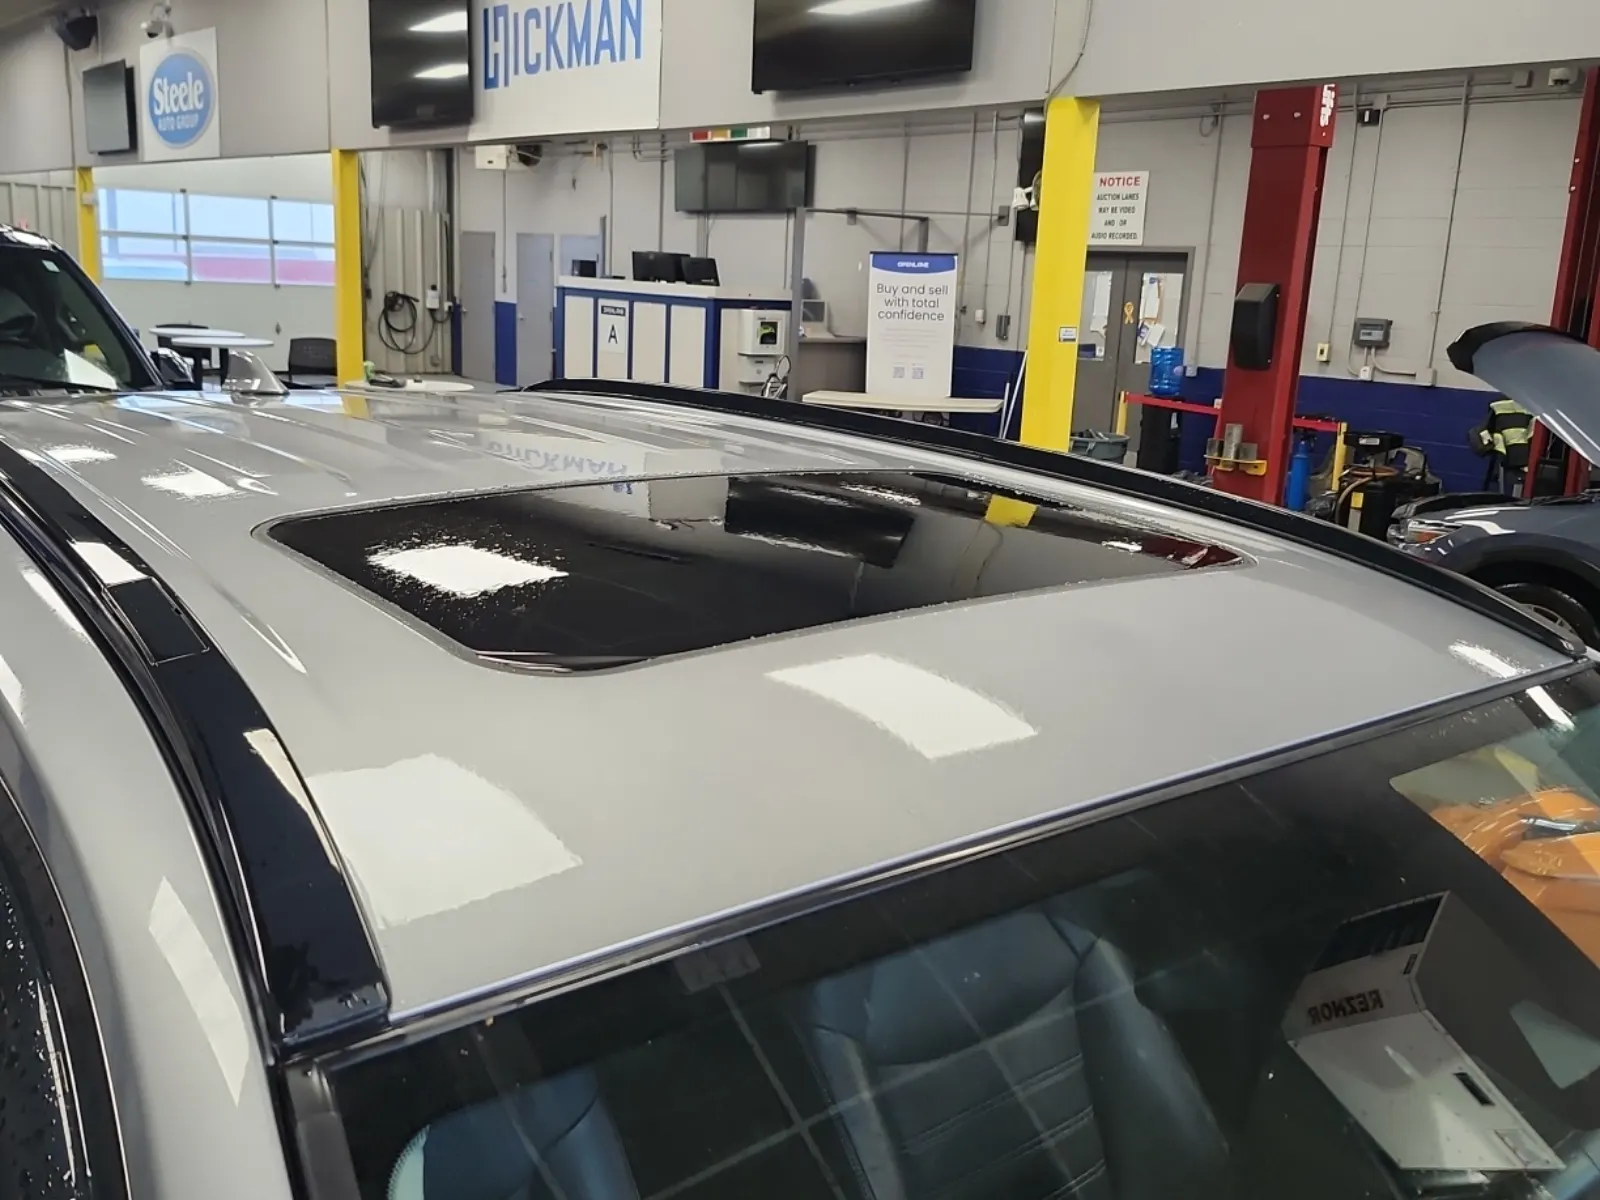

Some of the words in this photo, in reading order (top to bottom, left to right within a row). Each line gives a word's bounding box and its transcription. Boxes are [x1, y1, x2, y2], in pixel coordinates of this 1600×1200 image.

[483, 0, 643, 90] HICKMAN
[153, 71, 204, 116] Steele
[1099, 176, 1141, 187] NOTICE
[1096, 193, 1120, 201] AUCTION
[1121, 193, 1139, 201] LANES
[1098, 206, 1109, 214] MAY
[1111, 206, 1118, 214] BE
[1119, 206, 1136, 214] VIDEO
[1103, 219, 1116, 227] AND
[1118, 219, 1128, 227] OR
[1091, 232, 1107, 240] AUDIO
[876, 283, 899, 297] Buy
[901, 283, 926, 295] and
[928, 284, 949, 296] sell
[884, 297, 909, 308] with
[911, 298, 940, 309] total
[877, 309, 945, 321] confidence
[607, 323, 619, 345] A
